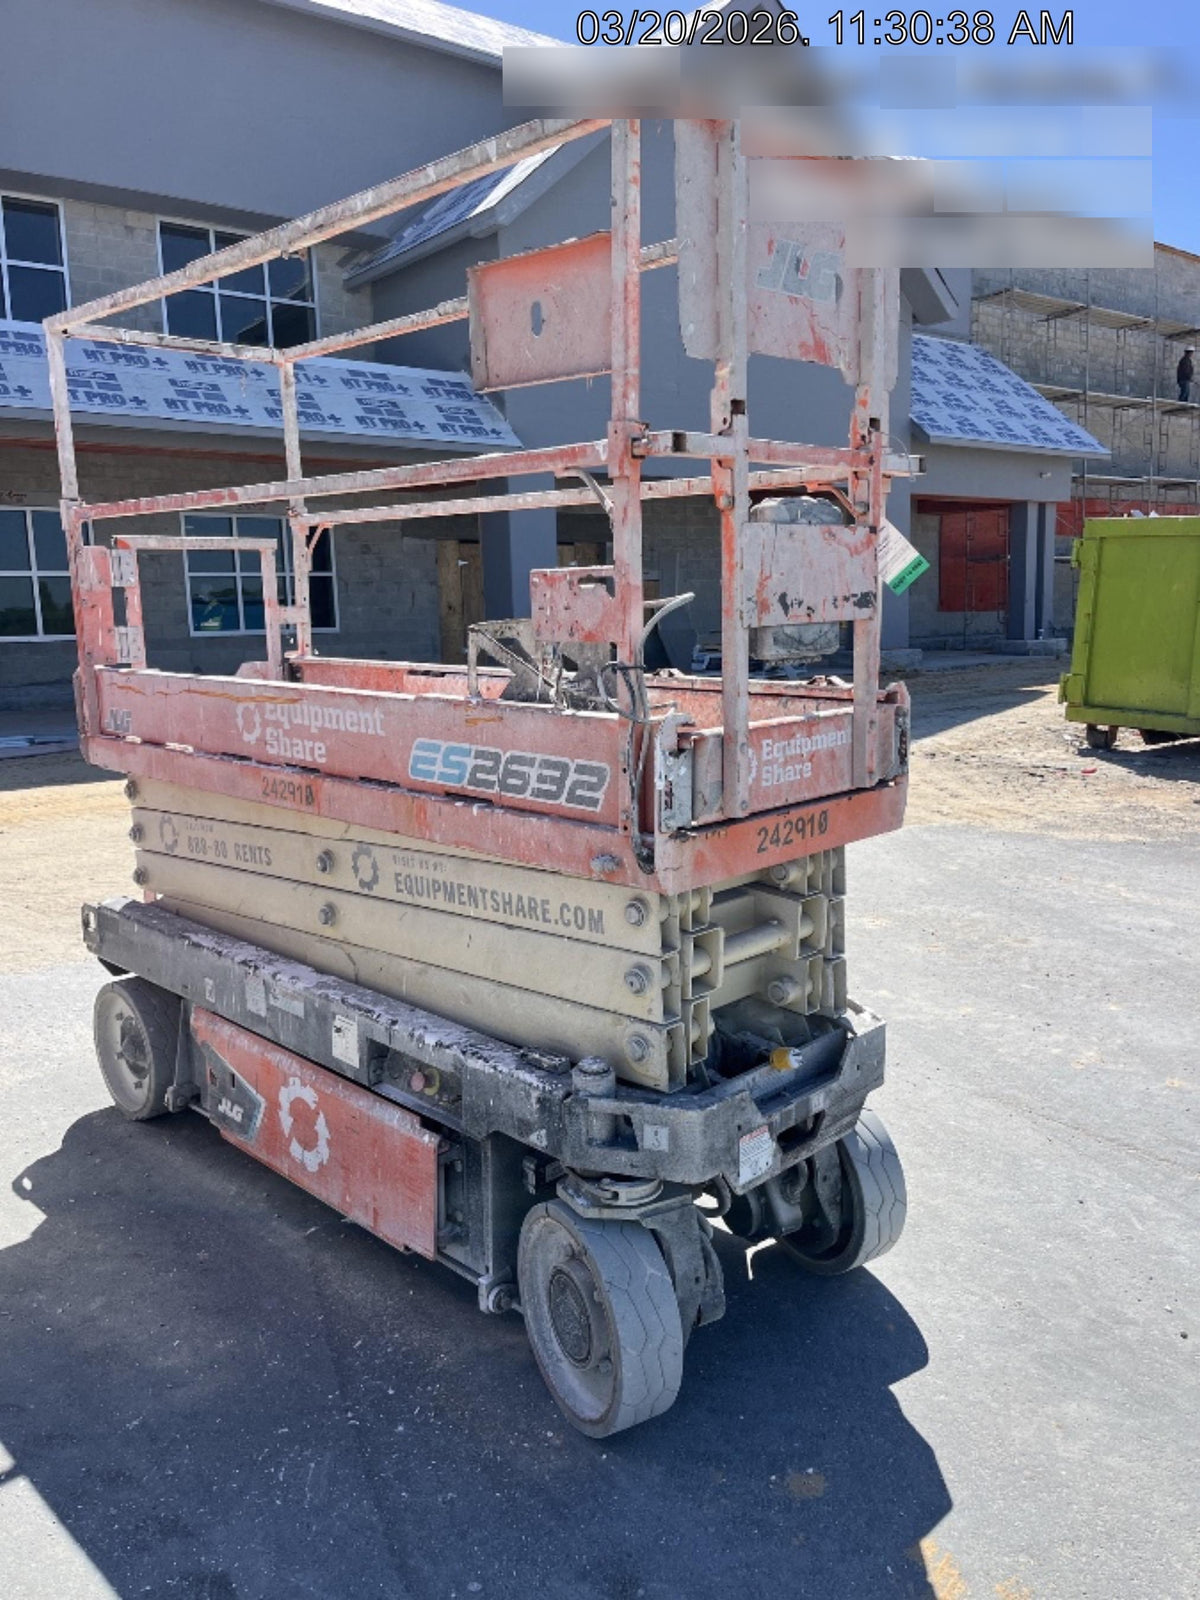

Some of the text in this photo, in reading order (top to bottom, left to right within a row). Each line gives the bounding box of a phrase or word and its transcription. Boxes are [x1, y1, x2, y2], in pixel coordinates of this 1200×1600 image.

[263, 701, 386, 737] Equipment
[265, 726, 327, 764] Share
[408, 738, 611, 812] ES2632
[761, 761, 812, 787] Share
[394, 872, 605, 935] EQUIPMENTSHARE.COM
[218, 1098, 244, 1122] JLG
